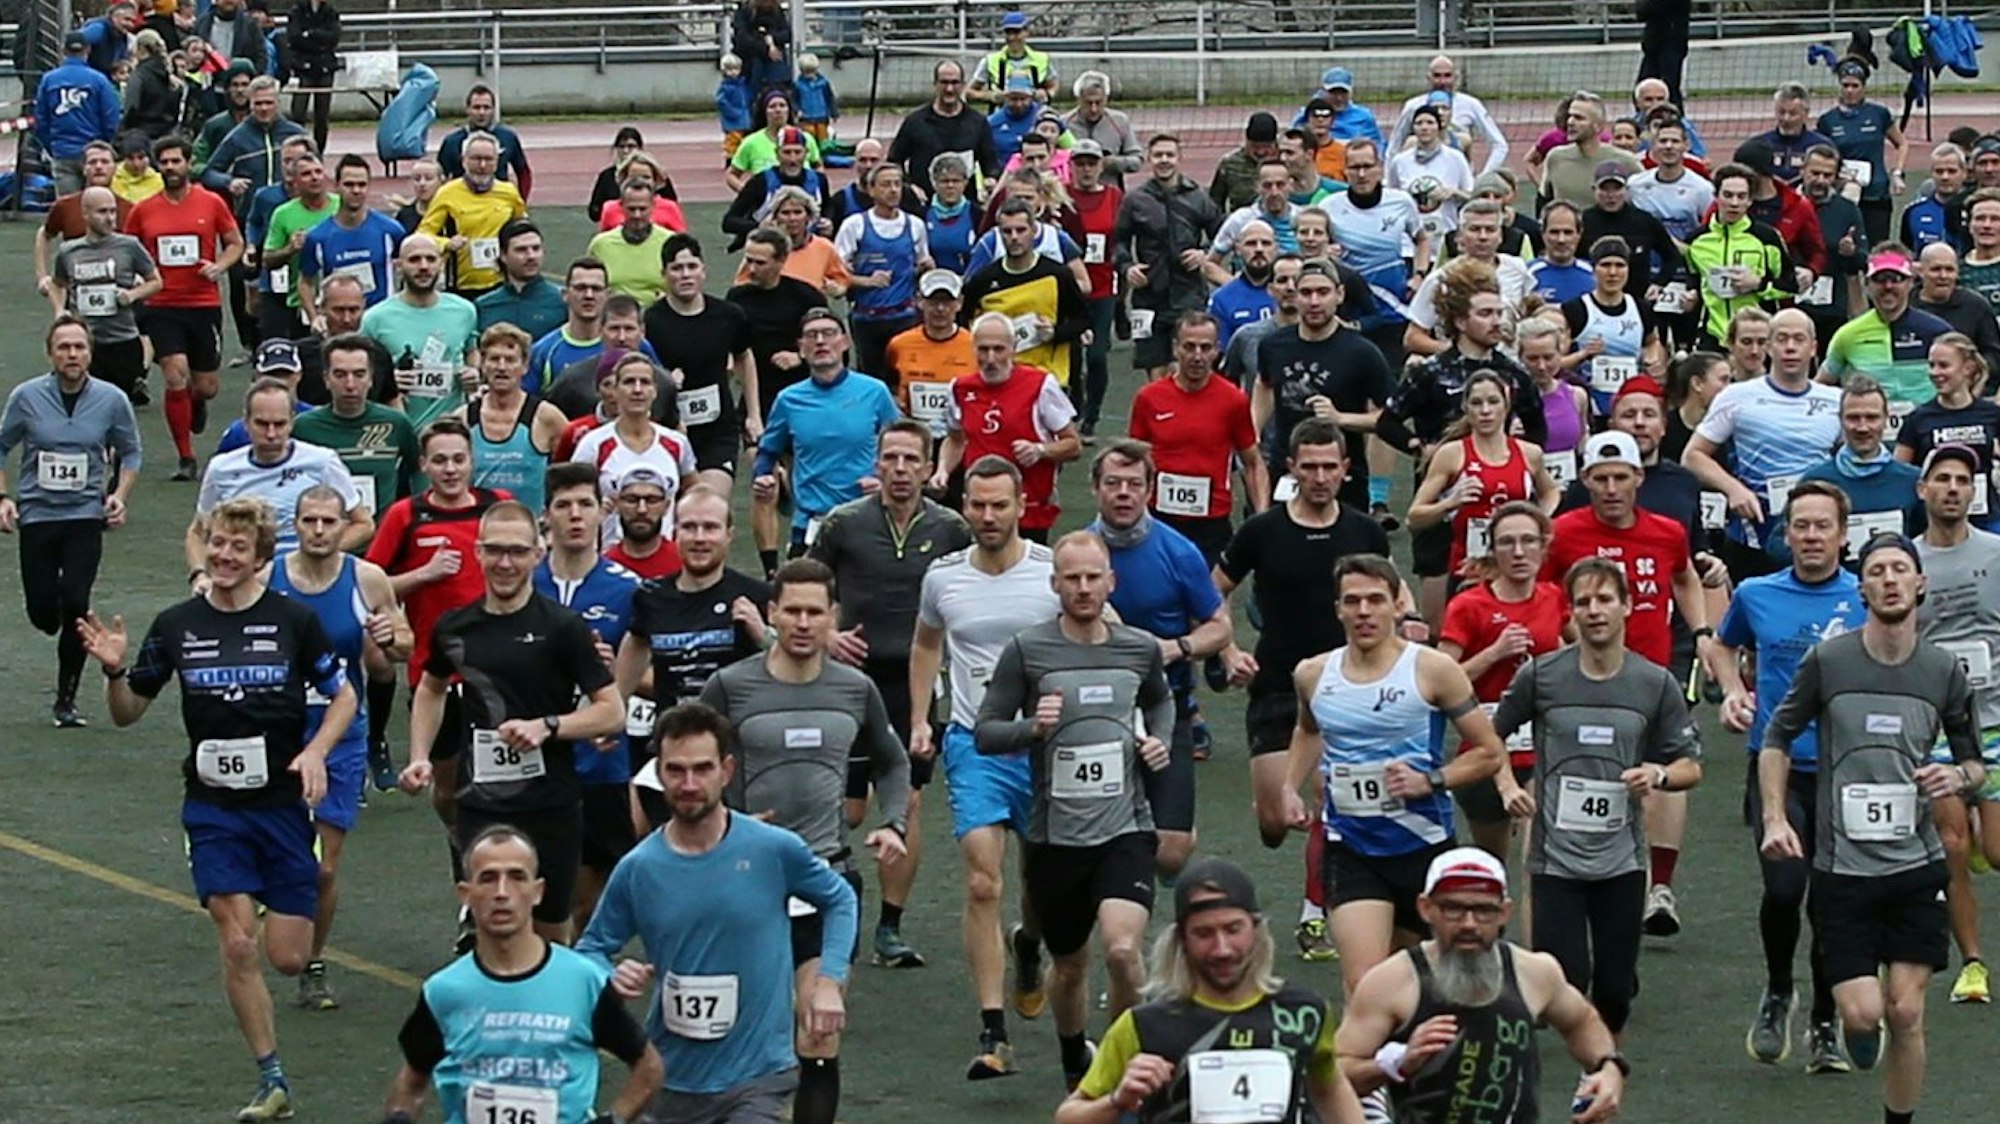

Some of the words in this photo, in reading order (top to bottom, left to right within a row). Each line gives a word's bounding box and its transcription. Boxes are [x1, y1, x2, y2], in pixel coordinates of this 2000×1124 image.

[484, 247, 497, 258] 61
[416, 373, 443, 387] 106
[1604, 368, 1627, 382] 131
[921, 394, 947, 409] 102
[49, 465, 78, 480] 134
[1167, 487, 1197, 504] 105
[632, 704, 656, 723] 47
[217, 755, 245, 775] 56
[492, 746, 521, 765] 38
[1074, 762, 1103, 782] 49
[1352, 780, 1379, 801] 19
[1581, 797, 1609, 817] 48
[1867, 802, 1892, 823] 51
[674, 994, 719, 1019] 137
[483, 1011, 570, 1031] REFRATH
[1233, 1074, 1251, 1100] 4
[485, 1105, 537, 1124] 136
